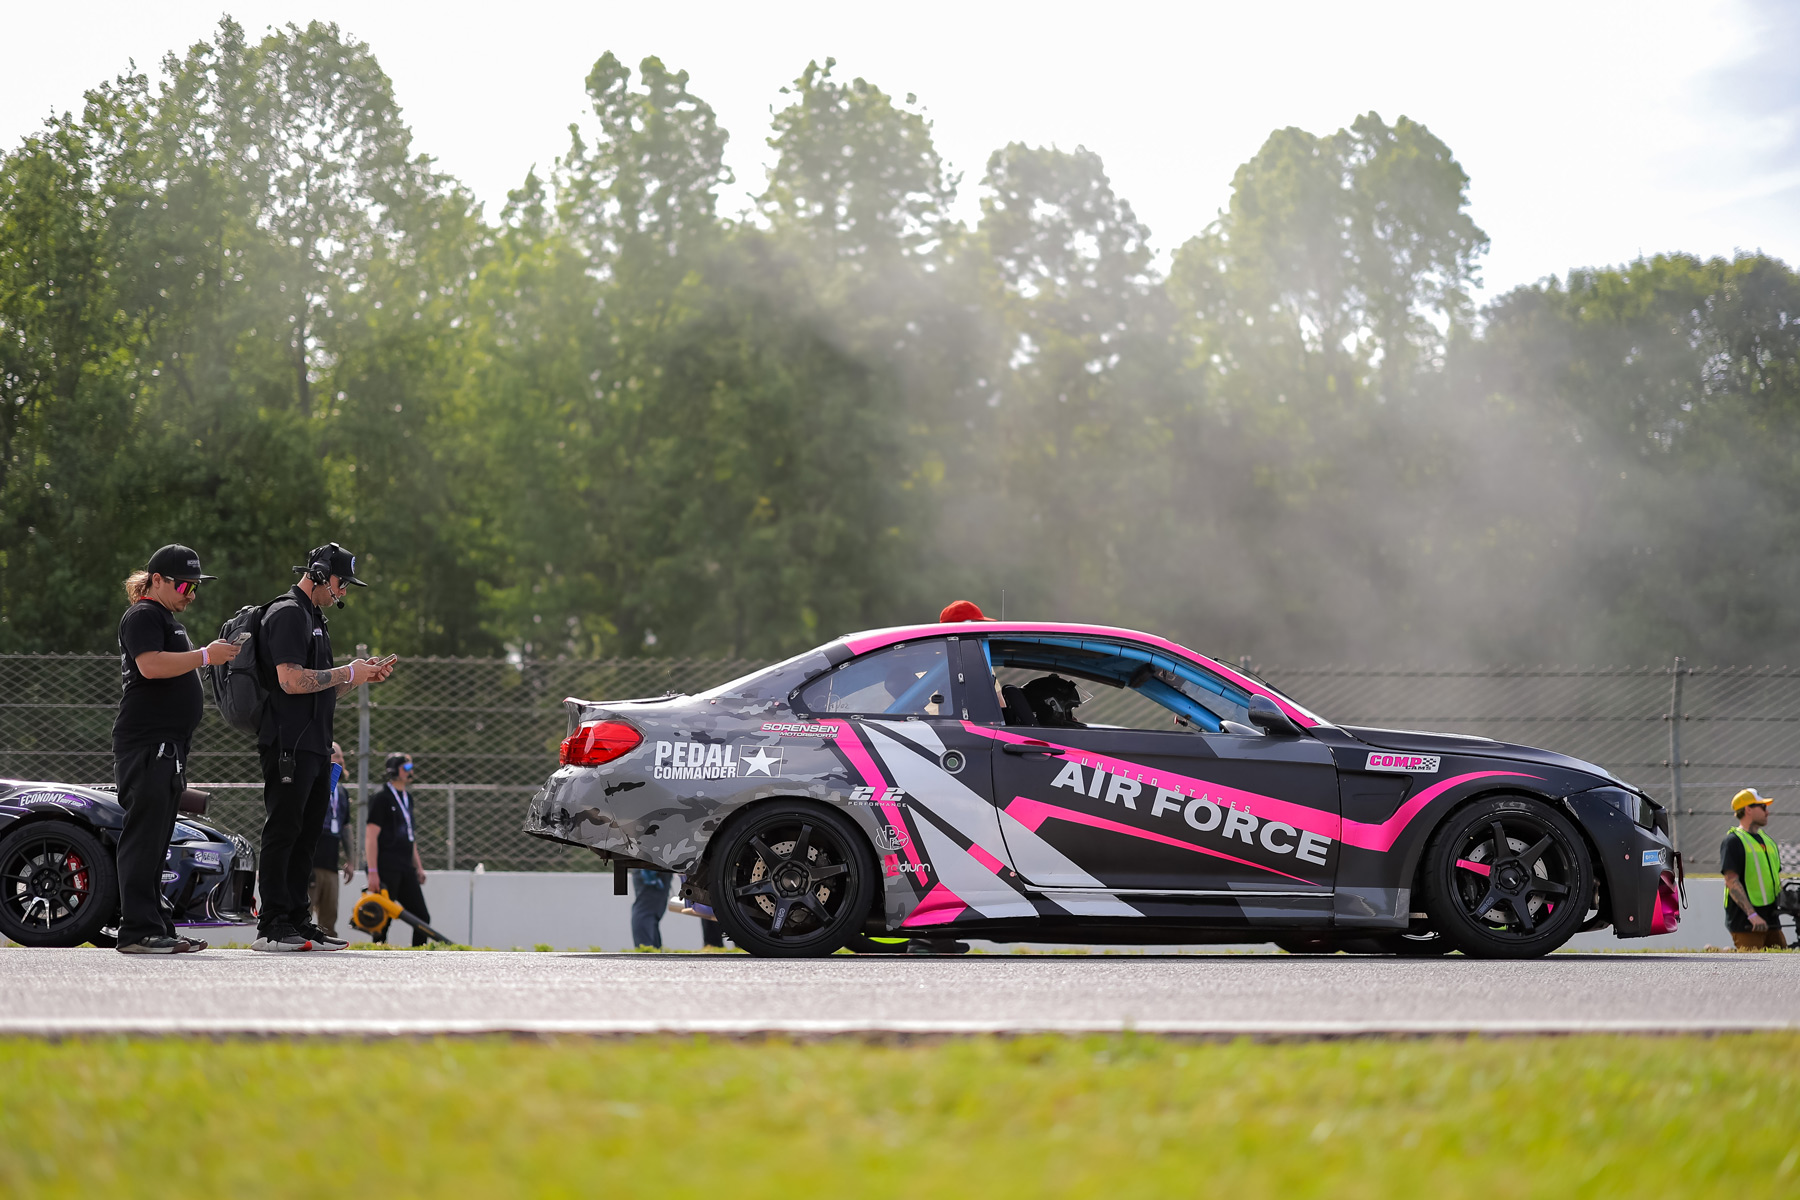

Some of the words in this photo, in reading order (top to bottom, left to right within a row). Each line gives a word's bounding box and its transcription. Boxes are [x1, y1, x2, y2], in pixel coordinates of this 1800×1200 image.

[762, 724, 839, 733] SORENSEN
[655, 741, 737, 767] PEDAL
[1370, 755, 1422, 767] COMP
[654, 766, 736, 780] COMMANDER
[1080, 757, 1158, 787] UNITED
[1174, 784, 1251, 815] STATES
[20, 793, 65, 806] ECONOMY
[1050, 760, 1142, 811] AIR
[1150, 786, 1332, 866] FORCE
